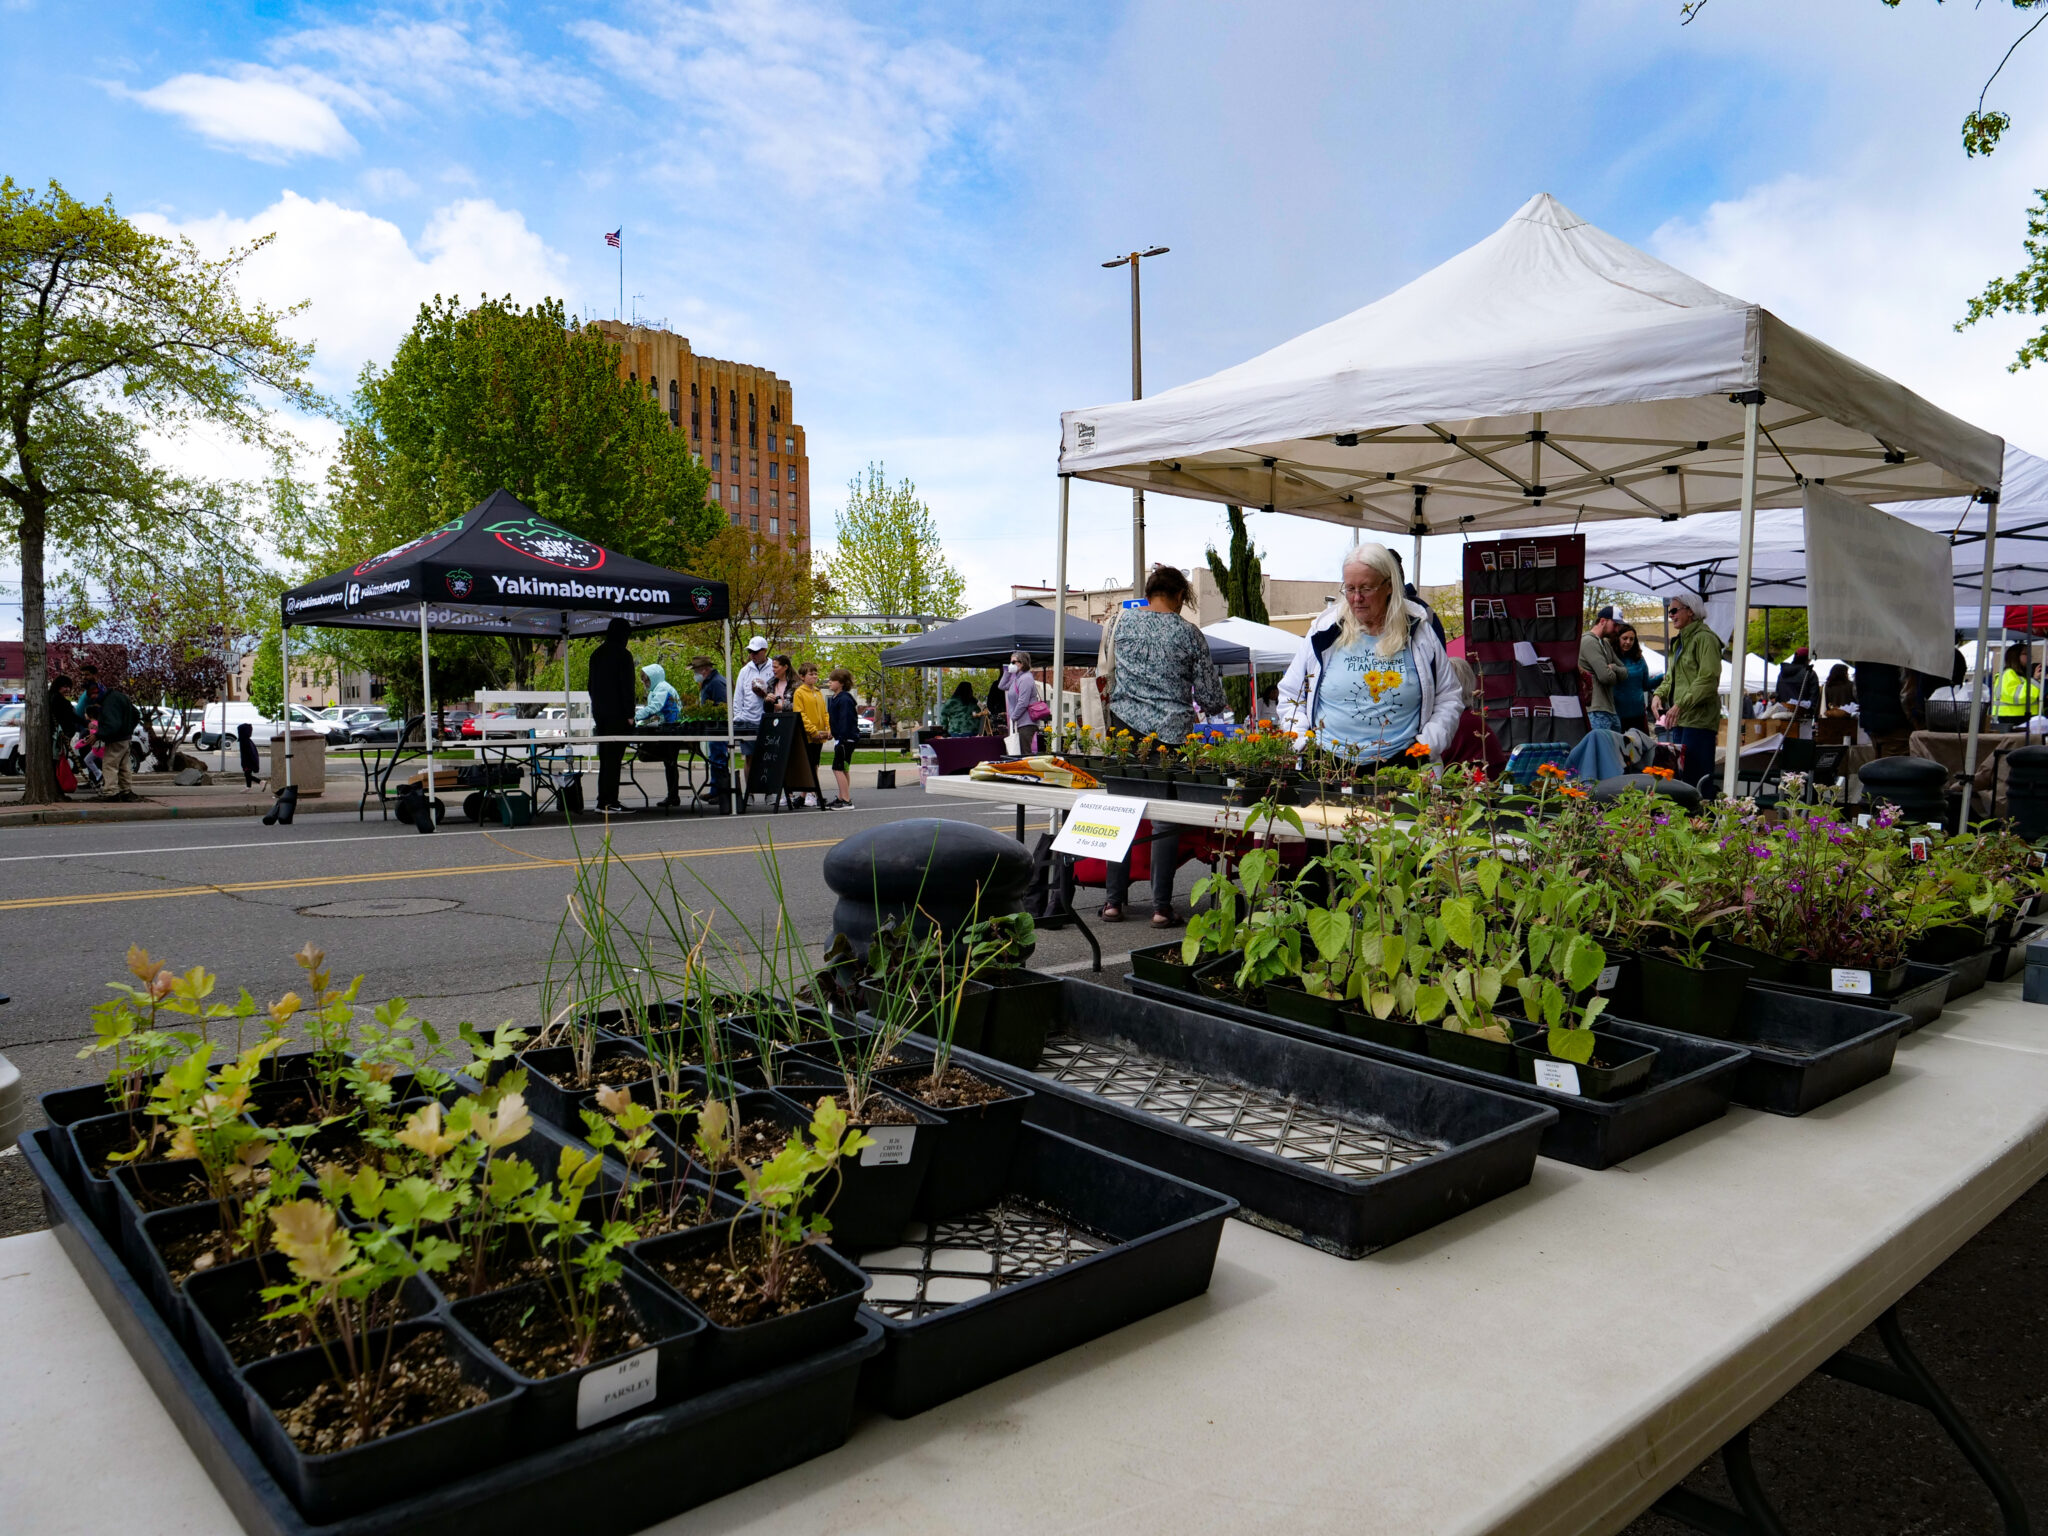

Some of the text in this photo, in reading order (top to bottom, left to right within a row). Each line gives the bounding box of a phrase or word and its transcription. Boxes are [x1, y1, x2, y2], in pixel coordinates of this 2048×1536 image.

[361, 579, 410, 599] yakimaberryco
[492, 575, 670, 603] Yakimaberry.com
[1380, 665, 1405, 673] SALE
[1080, 802, 1136, 814] MASTER GARDENERS
[1071, 824, 1119, 838] MARIGOLDS
[1090, 840, 1107, 848] $3.00
[618, 1360, 640, 1374] H 50
[604, 1379, 650, 1403] PARSLEY
